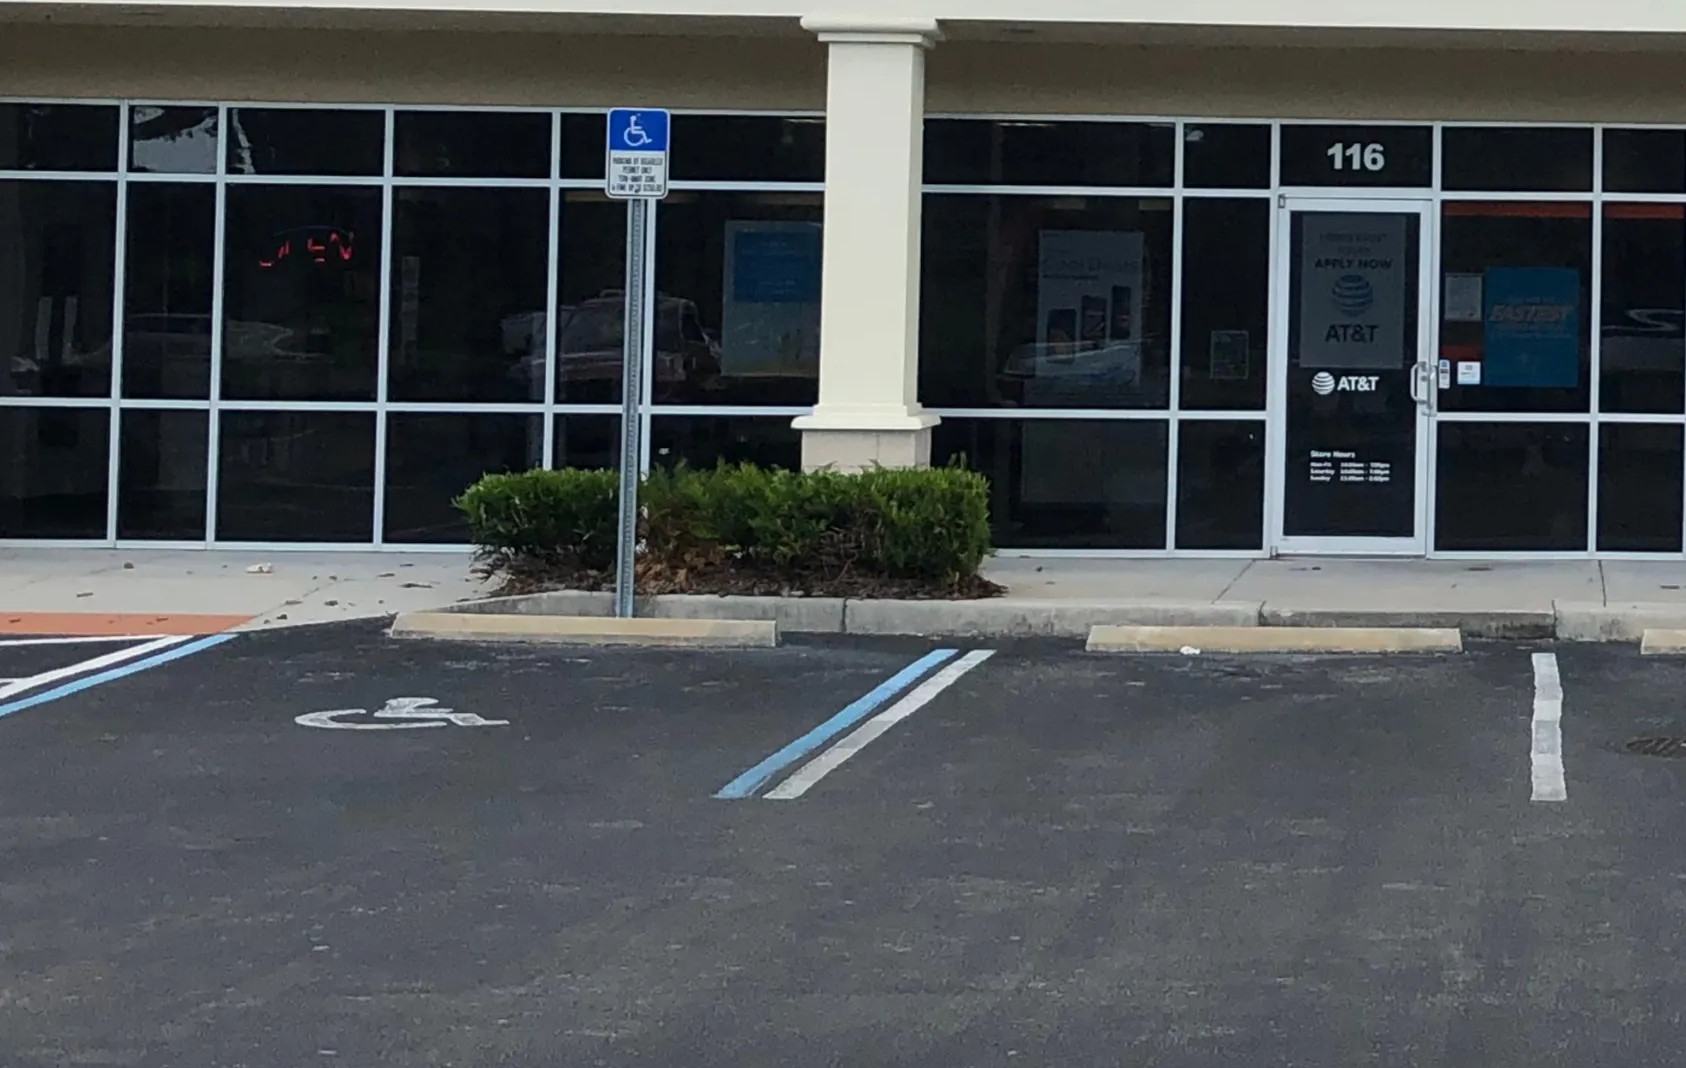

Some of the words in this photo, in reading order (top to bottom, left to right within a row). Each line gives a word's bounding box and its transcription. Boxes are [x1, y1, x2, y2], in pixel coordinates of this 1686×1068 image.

[1327, 142, 1385, 171] 116
[1314, 258, 1355, 270] APPLY
[1357, 258, 1394, 270] NOW
[1325, 324, 1380, 343] AT&T
[1337, 375, 1380, 392] AT&T
[1310, 450, 1332, 459] Store
[1333, 451, 1356, 459] Hours
